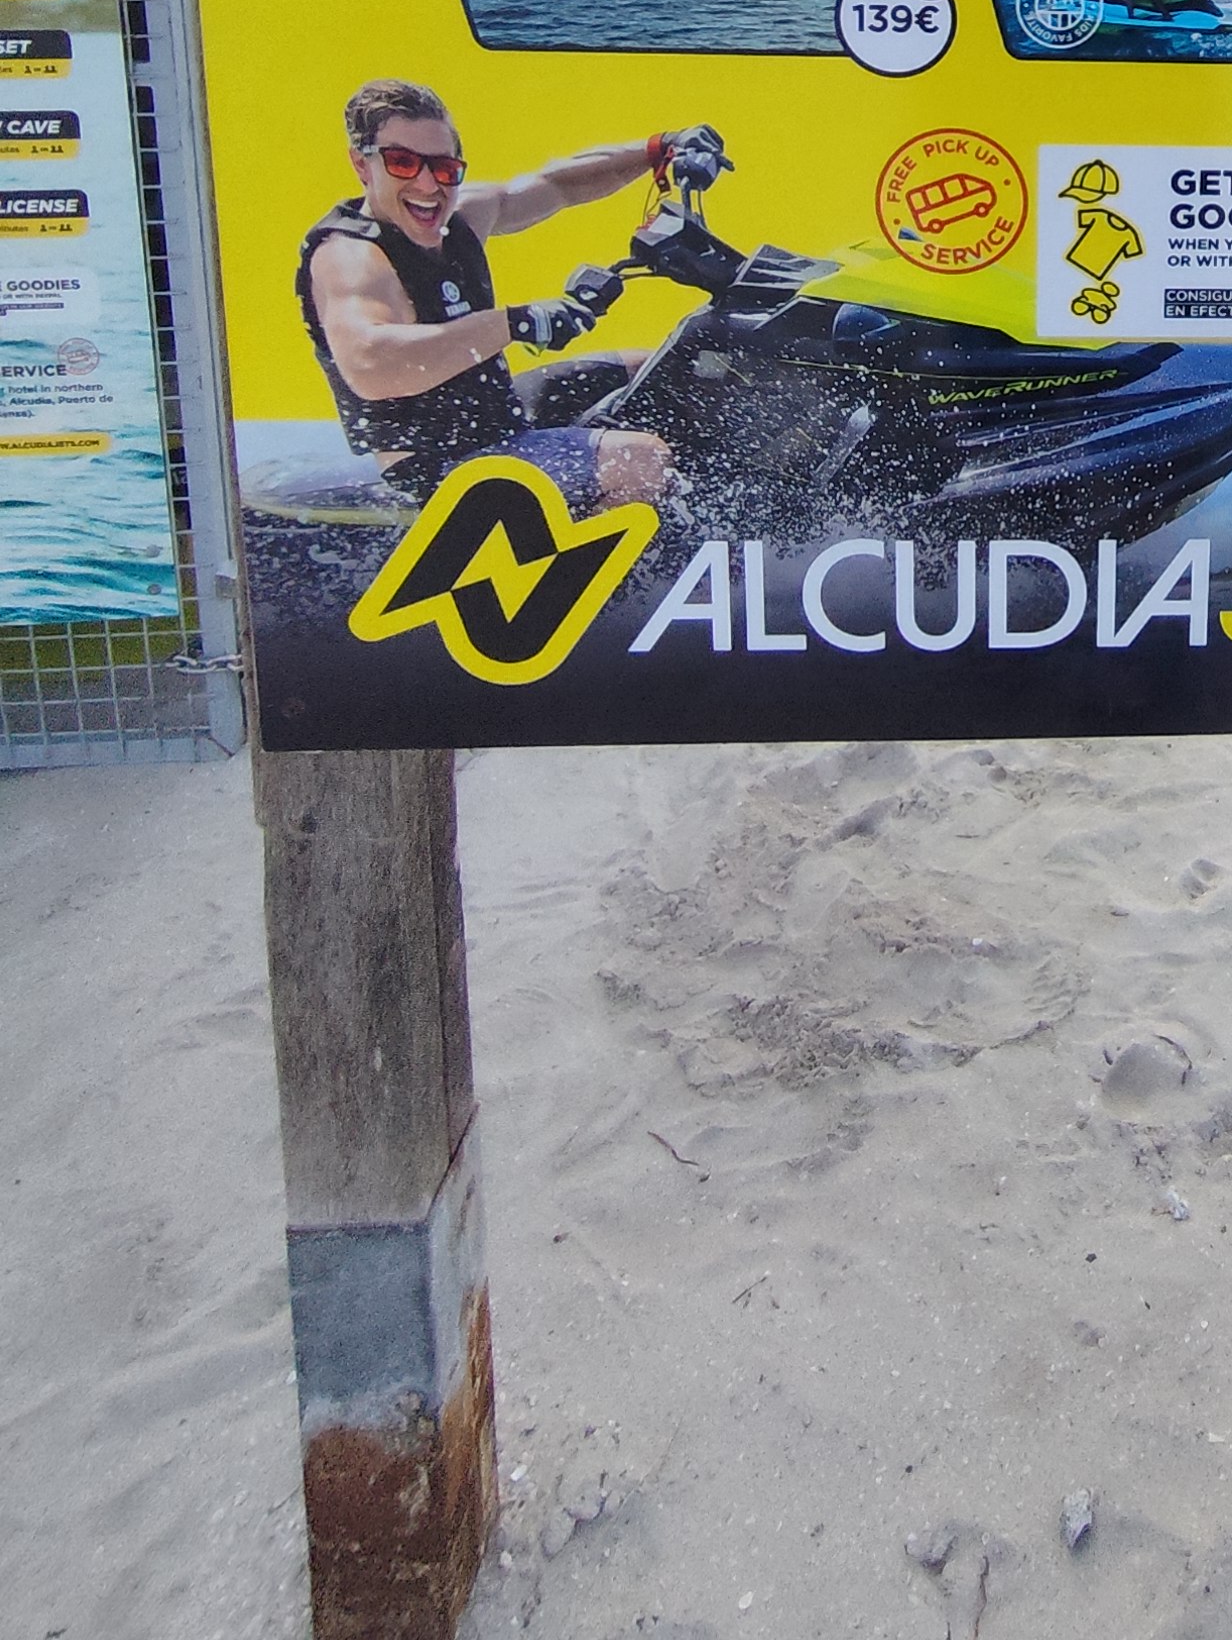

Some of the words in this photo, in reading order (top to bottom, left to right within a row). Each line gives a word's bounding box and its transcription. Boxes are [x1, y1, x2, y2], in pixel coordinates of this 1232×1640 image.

[851, 3, 942, 35] 139€
[7, 119, 62, 135] CAVE
[886, 156, 917, 203] FREE
[922, 139, 970, 158] PICK
[974, 145, 1000, 167] UP
[921, 216, 1015, 265] SERVICE
[1168, 238, 1220, 251] WHEN
[1167, 255, 1192, 268] OR
[7, 279, 81, 292] GOODIES
[1166, 305, 1186, 317] EN
[0, 364, 67, 377] ERVICE
